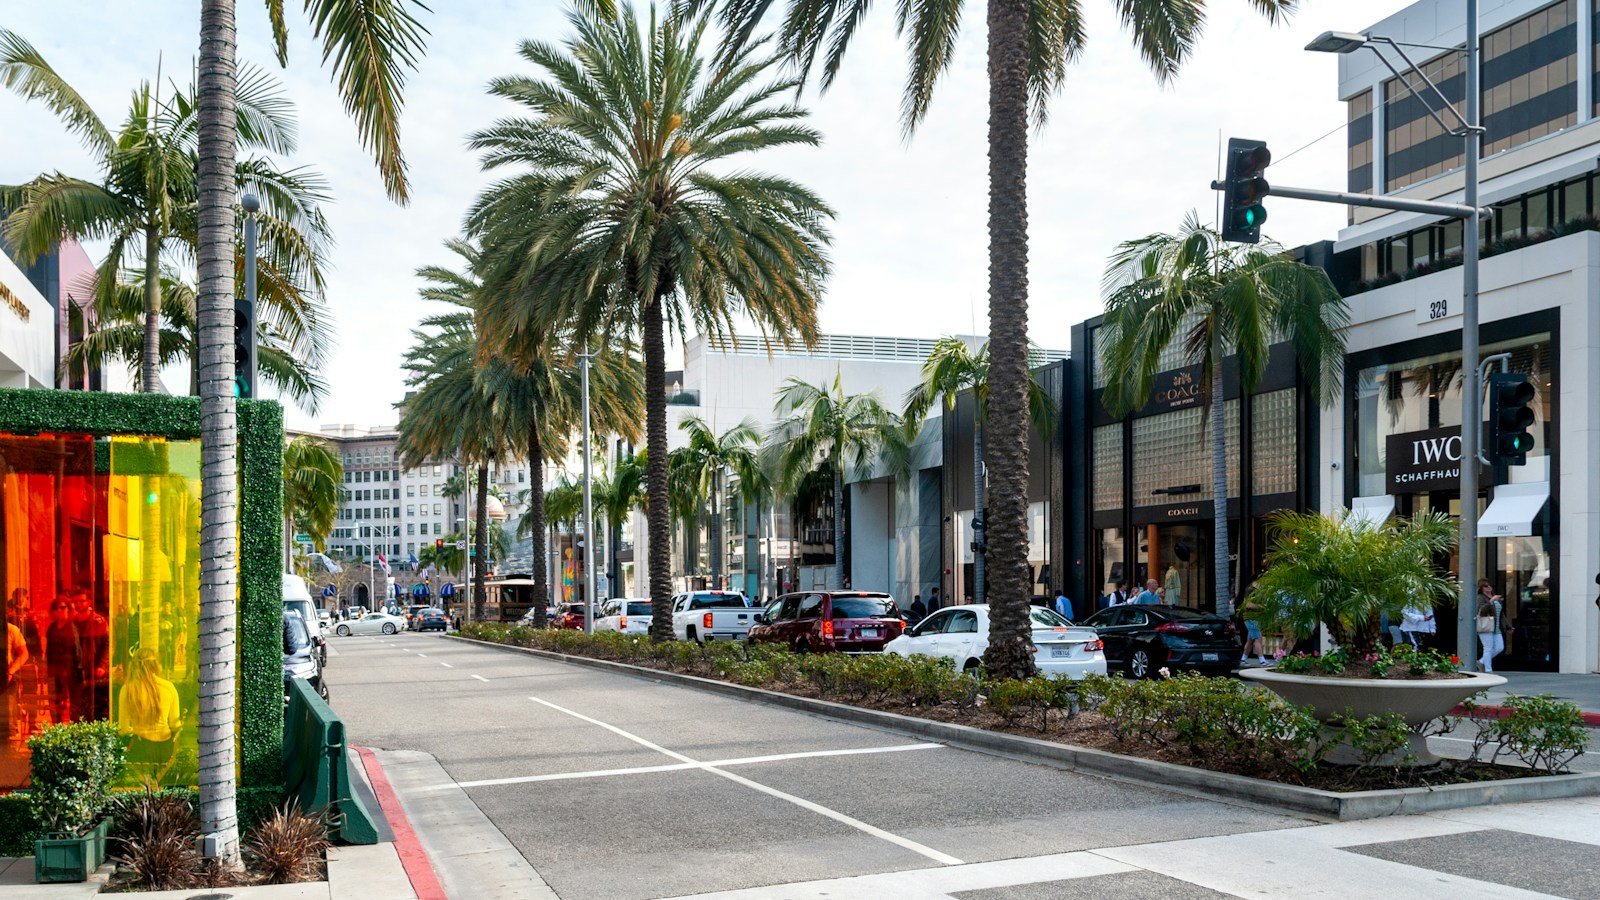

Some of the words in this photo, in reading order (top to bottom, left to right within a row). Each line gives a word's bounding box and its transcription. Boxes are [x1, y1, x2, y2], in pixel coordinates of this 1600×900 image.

[1430, 299, 1447, 319] 329
[1155, 384, 1205, 404] COAC
[1412, 435, 1463, 466] IWC
[1395, 467, 1460, 483] SCHAFFHAU
[1167, 507, 1199, 517] COACH
